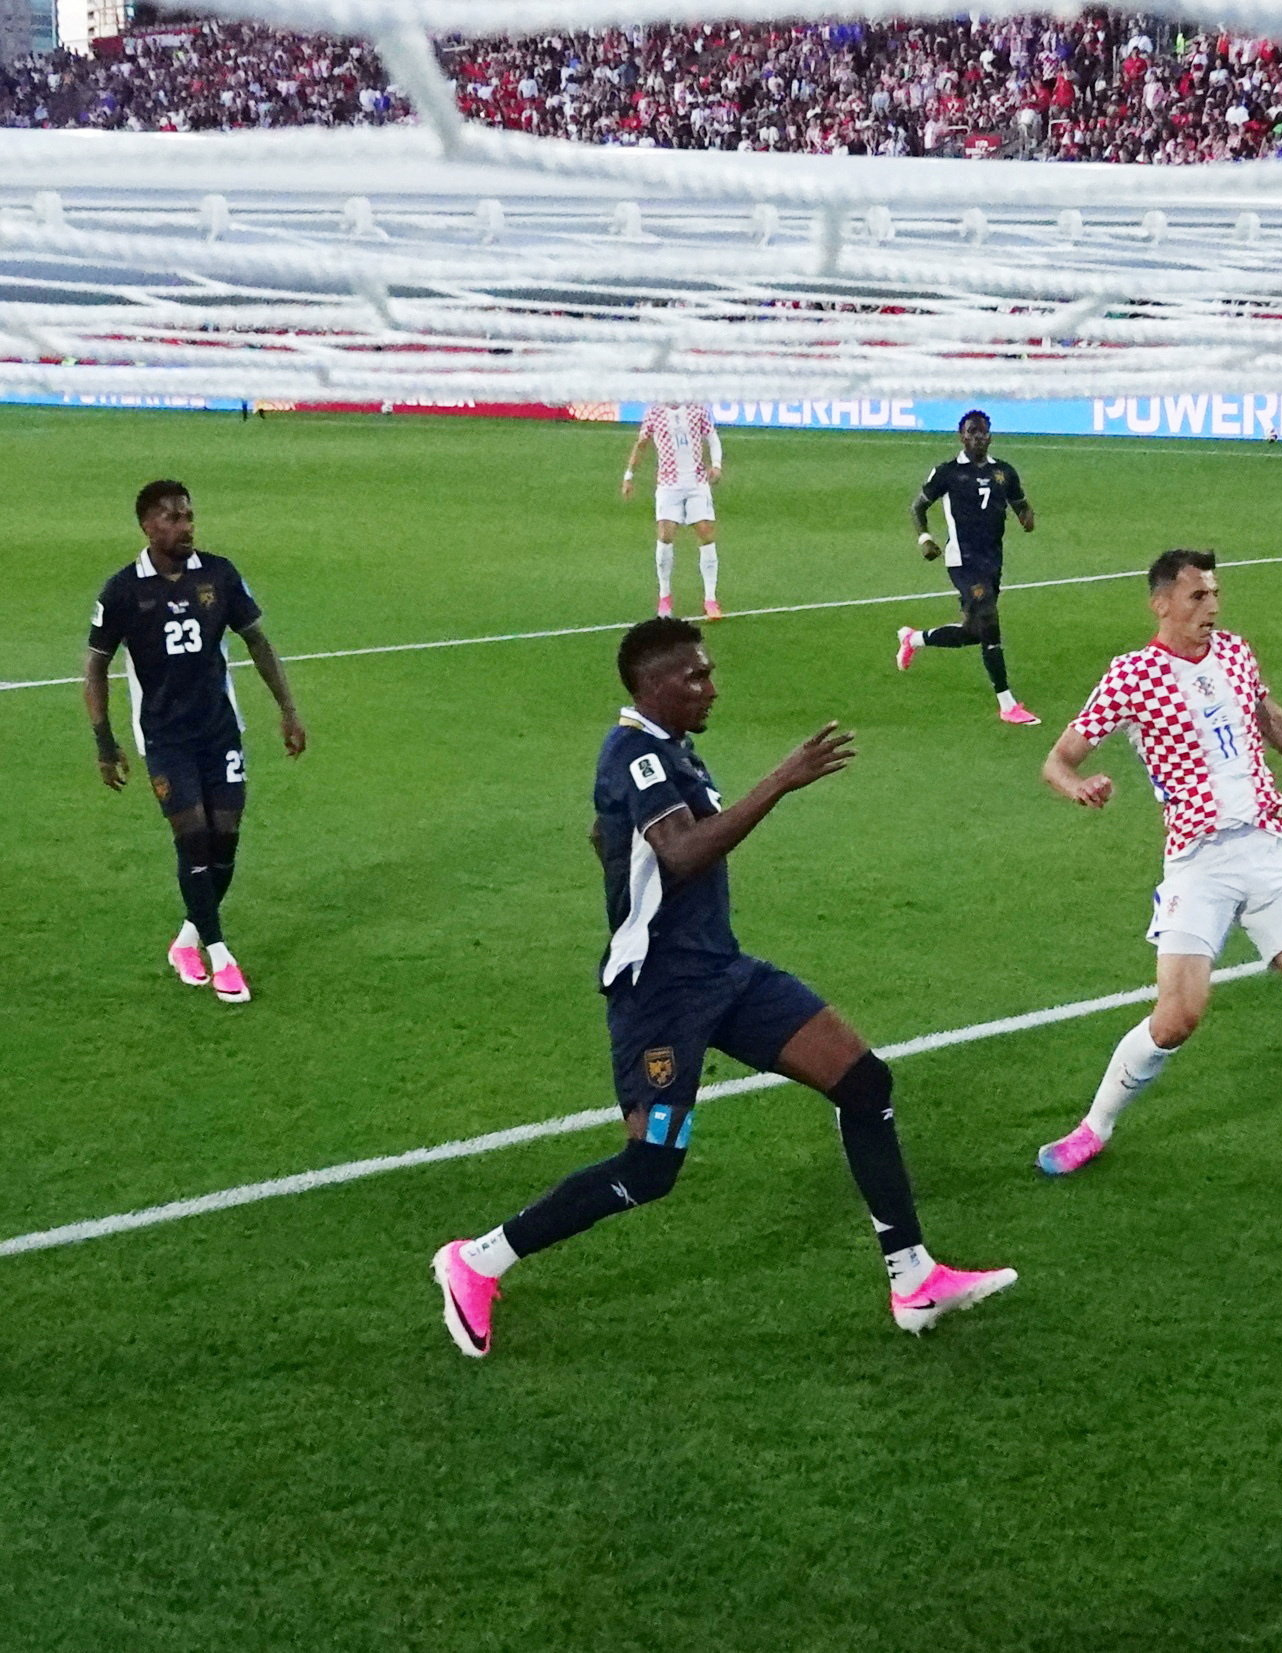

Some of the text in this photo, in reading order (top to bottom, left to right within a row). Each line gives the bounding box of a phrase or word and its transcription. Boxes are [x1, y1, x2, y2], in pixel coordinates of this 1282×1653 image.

[711, 398, 918, 427] OWERADE
[978, 487, 991, 510] 7
[164, 618, 203, 655] 23
[1213, 724, 1239, 759] 11
